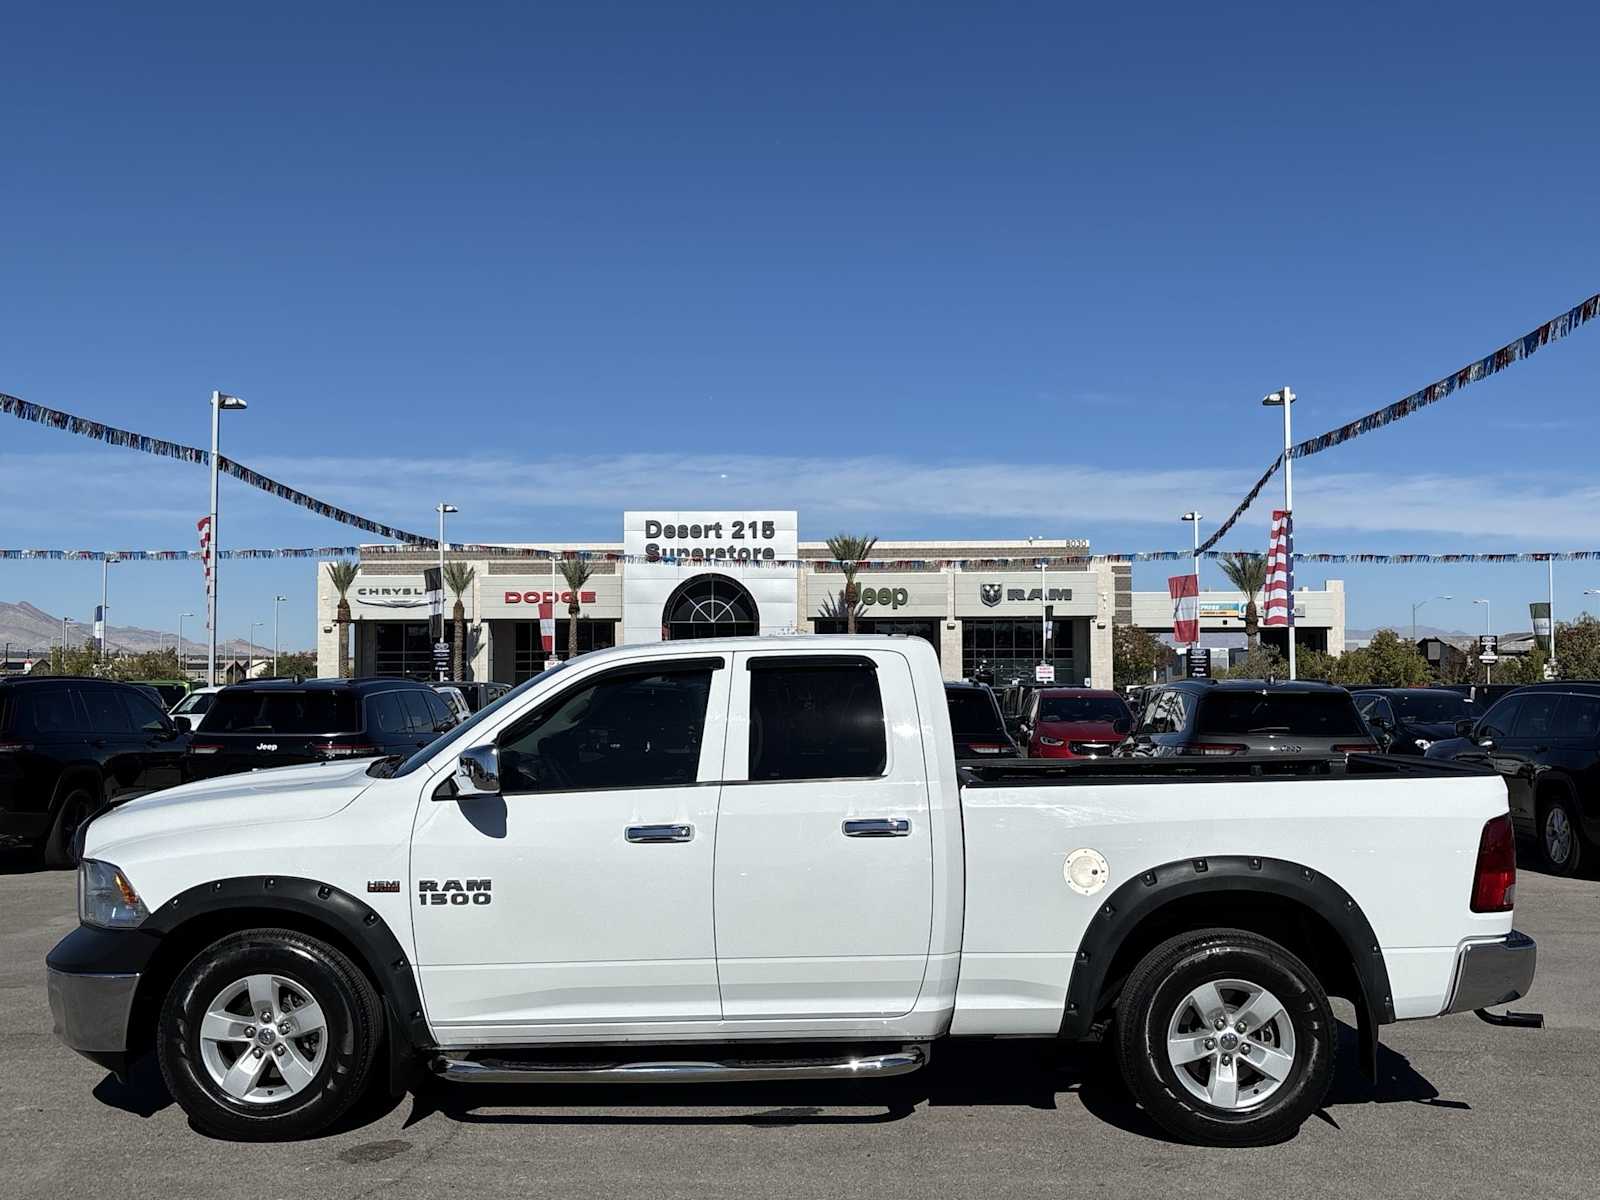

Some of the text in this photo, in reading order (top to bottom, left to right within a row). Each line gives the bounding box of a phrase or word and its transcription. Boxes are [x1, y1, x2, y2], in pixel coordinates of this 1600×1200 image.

[645, 520, 775, 539] Desert 215
[645, 543, 775, 562] Superstore
[357, 588, 428, 596] CHRYSL
[1007, 588, 1073, 601] RAM
[256, 743, 278, 751] Jeep
[418, 880, 492, 891] RAM
[418, 893, 492, 905] 1500
